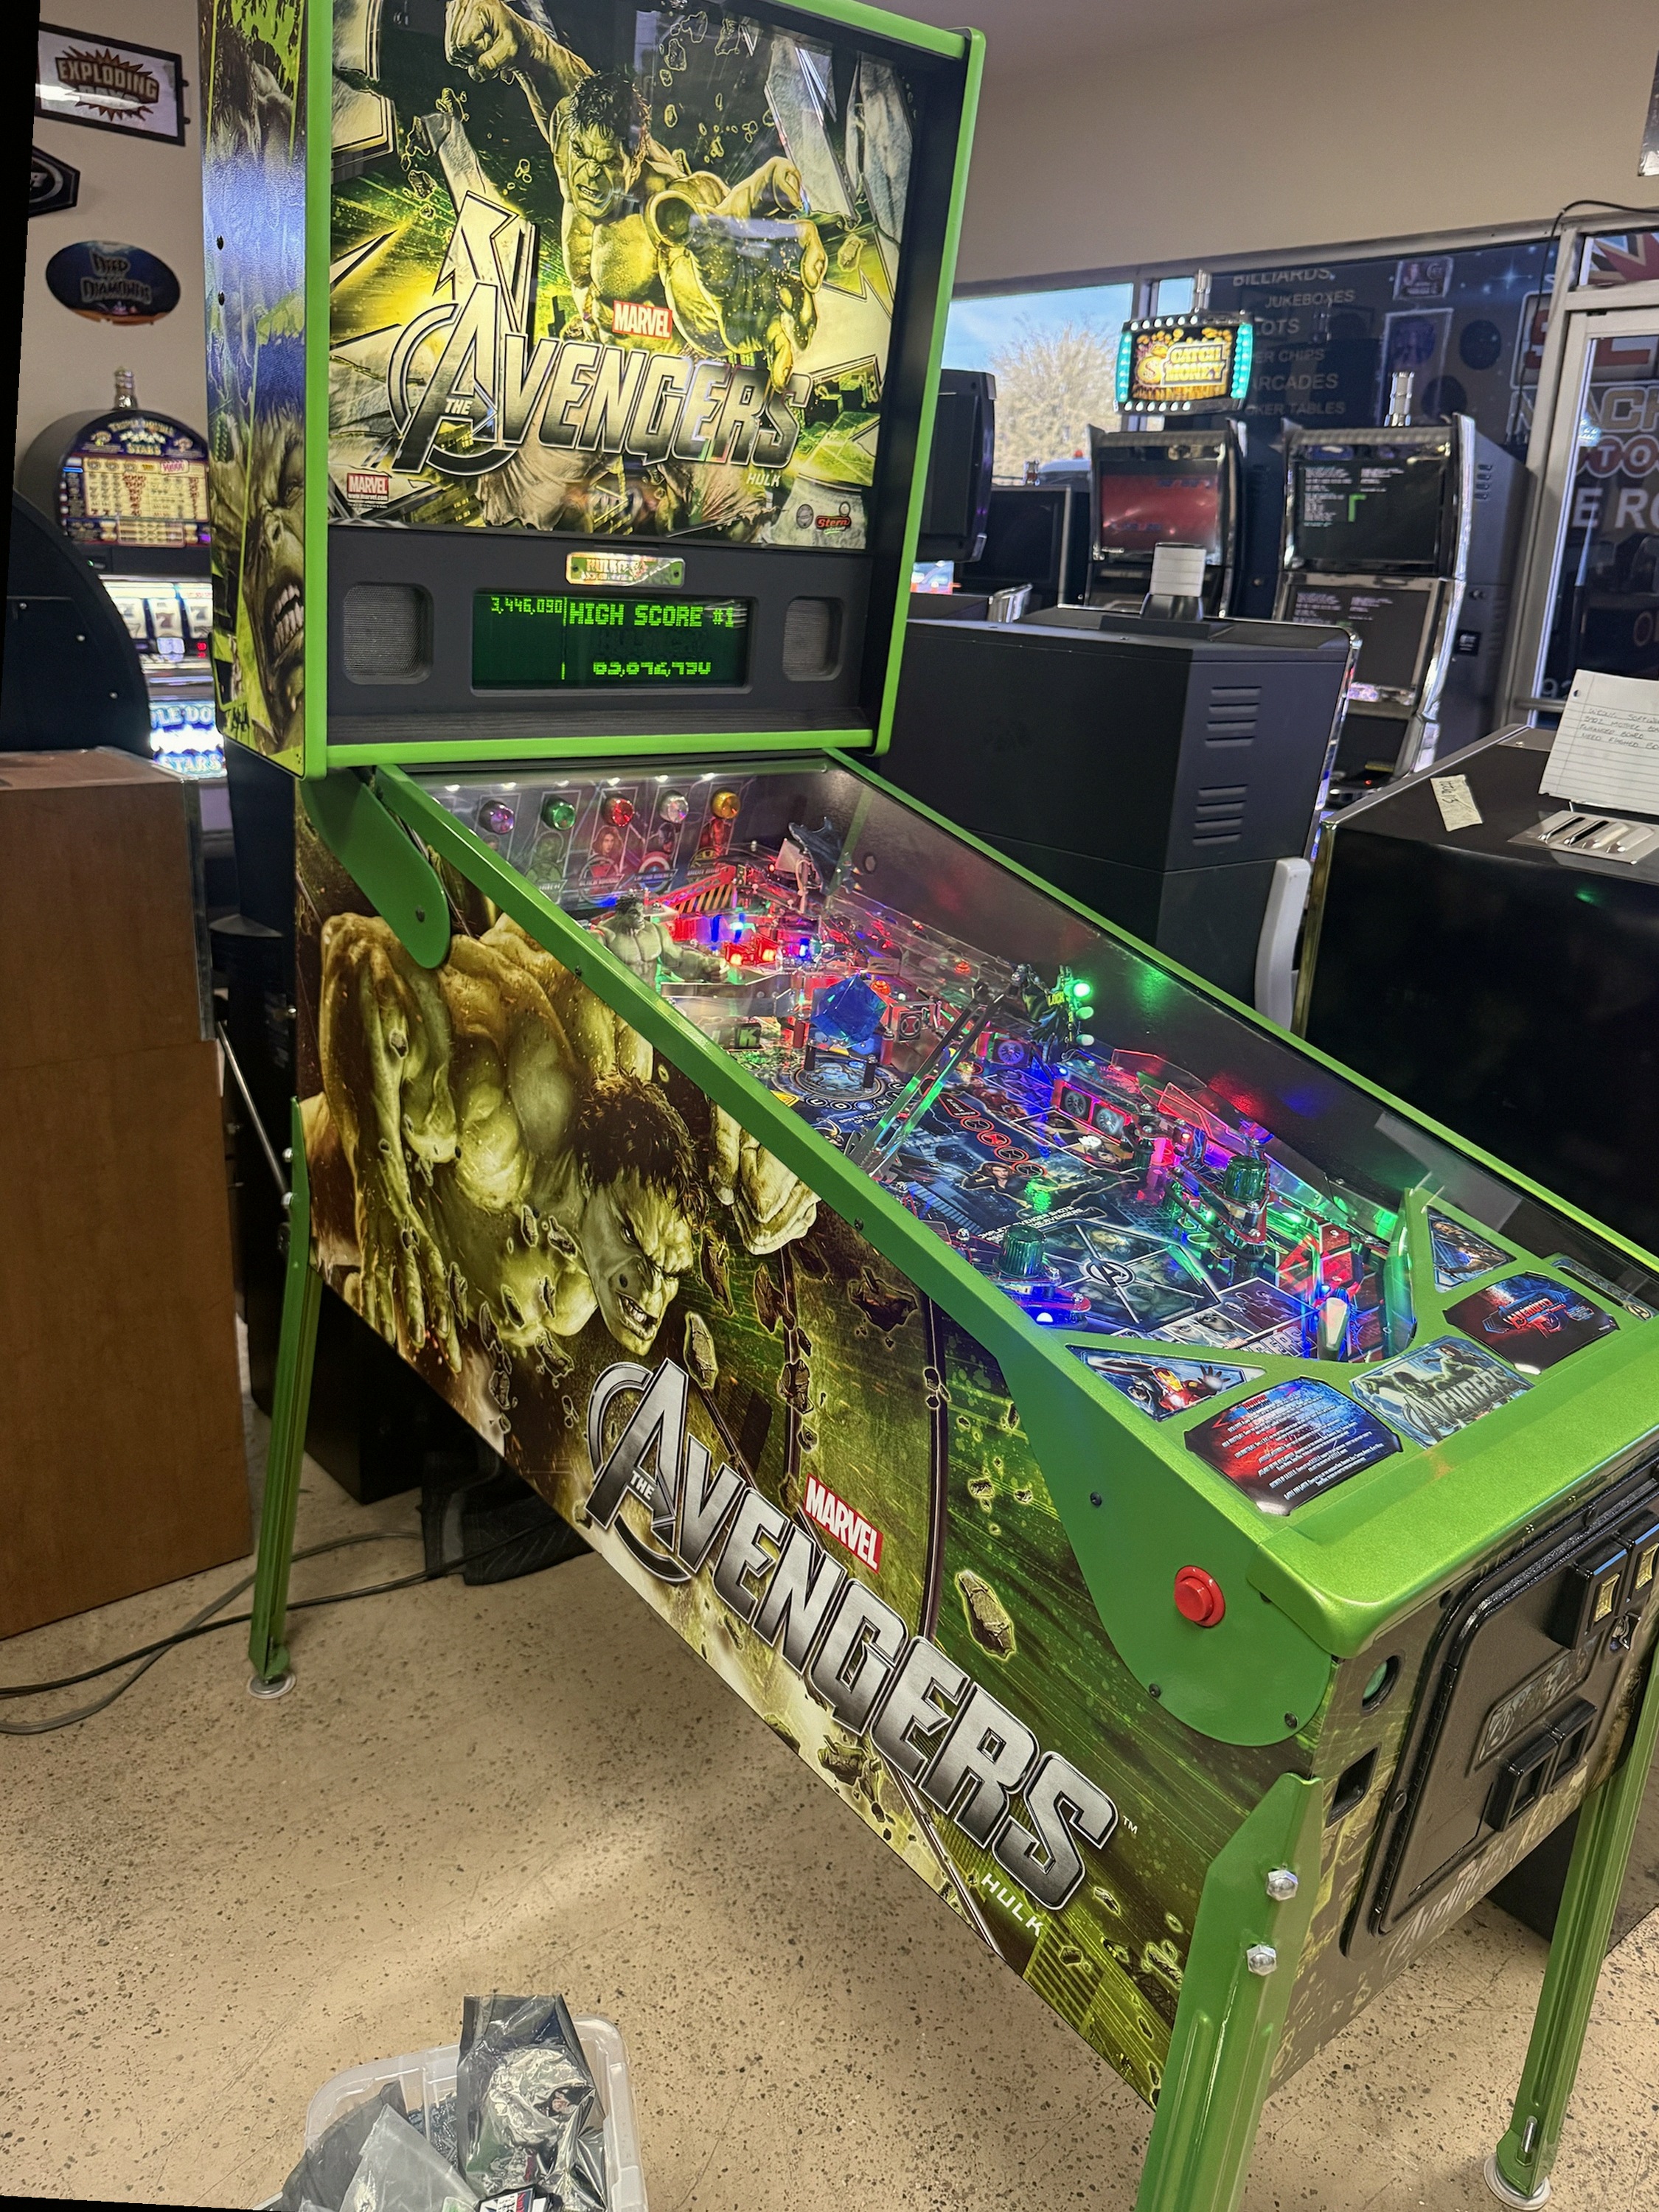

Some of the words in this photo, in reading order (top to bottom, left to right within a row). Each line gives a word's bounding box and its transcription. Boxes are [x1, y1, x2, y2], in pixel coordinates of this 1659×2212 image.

[58, 59, 157, 100] EXPLODING
[1265, 290, 1356, 308] JUKEBOXES
[615, 303, 672, 338] MARVEL
[1169, 347, 1222, 364] CATCH
[388, 283, 813, 476] AVENGERS
[1164, 361, 1225, 381] MONEY
[445, 397, 472, 415] THE
[348, 475, 389, 495] MARVEL
[746, 473, 782, 487] HULK
[817, 518, 849, 529] Stern
[490, 596, 563, 616] 3,446,090
[569, 602, 625, 625] HIGH
[634, 604, 704, 627] SCORE
[712, 607, 734, 627] #1
[1581, 732, 1602, 742] NEED
[630, 1470, 655, 1502] THE
[806, 1478, 880, 1571] MARVEL
[585, 1357, 1119, 1910] AVENGERS
[981, 1873, 1044, 1938] HULK
